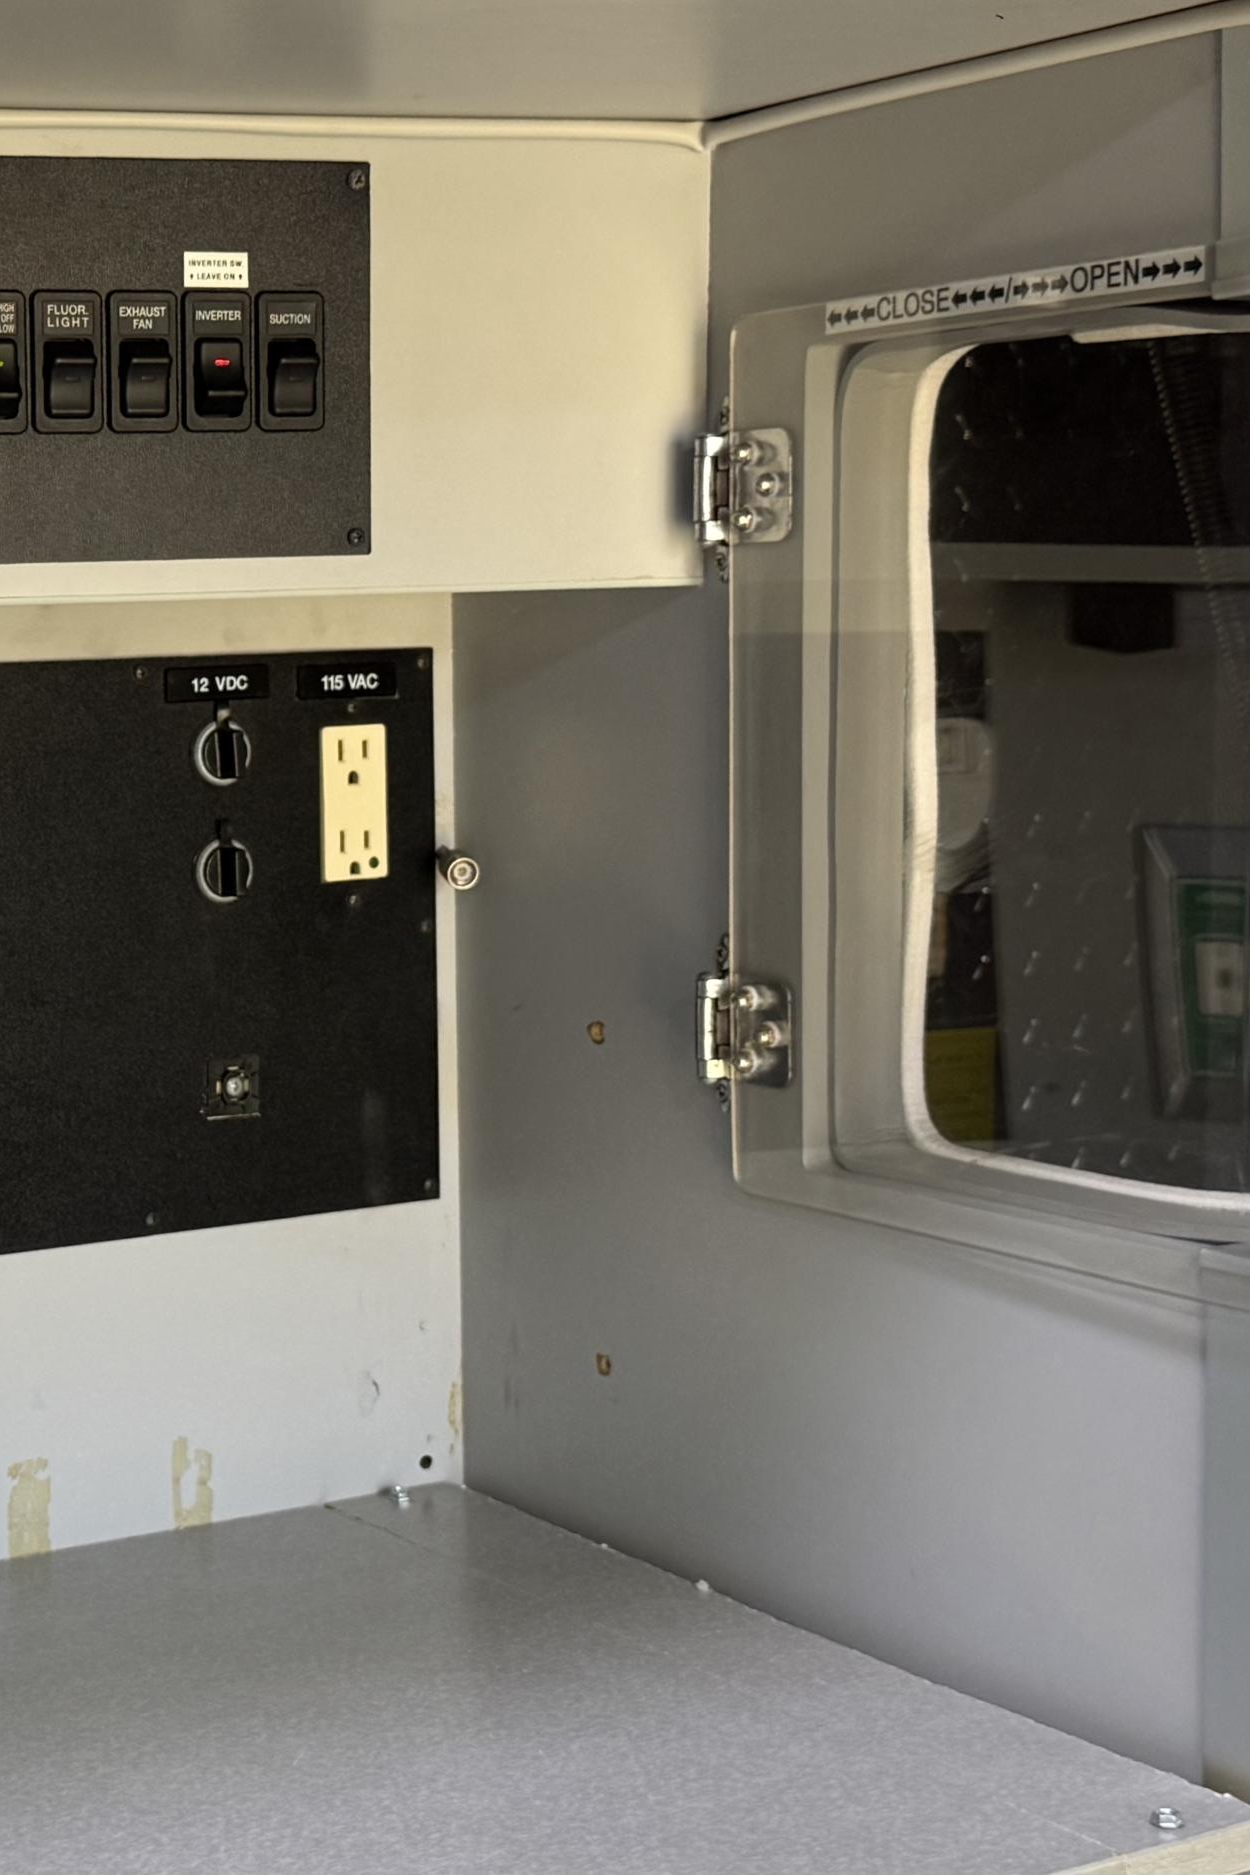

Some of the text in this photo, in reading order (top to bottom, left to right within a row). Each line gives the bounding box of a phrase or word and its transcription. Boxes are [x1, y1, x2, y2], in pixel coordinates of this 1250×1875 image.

[188, 259, 228, 267] INVERTER
[196, 273, 236, 281] LEAVE ON
[876, 287, 951, 323] CLOSE
[1069, 258, 1141, 293] OPEN
[46, 304, 89, 315] FLUOR.
[118, 306, 167, 317] EXHAUST
[195, 309, 242, 321] INVERTER
[0, 313, 14, 323] OFF
[46, 317, 90, 328] LIGHT
[269, 313, 311, 324] SUCTION
[132, 319, 153, 329] FAN
[191, 675, 248, 693] 12 VDC
[320, 673, 379, 691] 115 VAC
